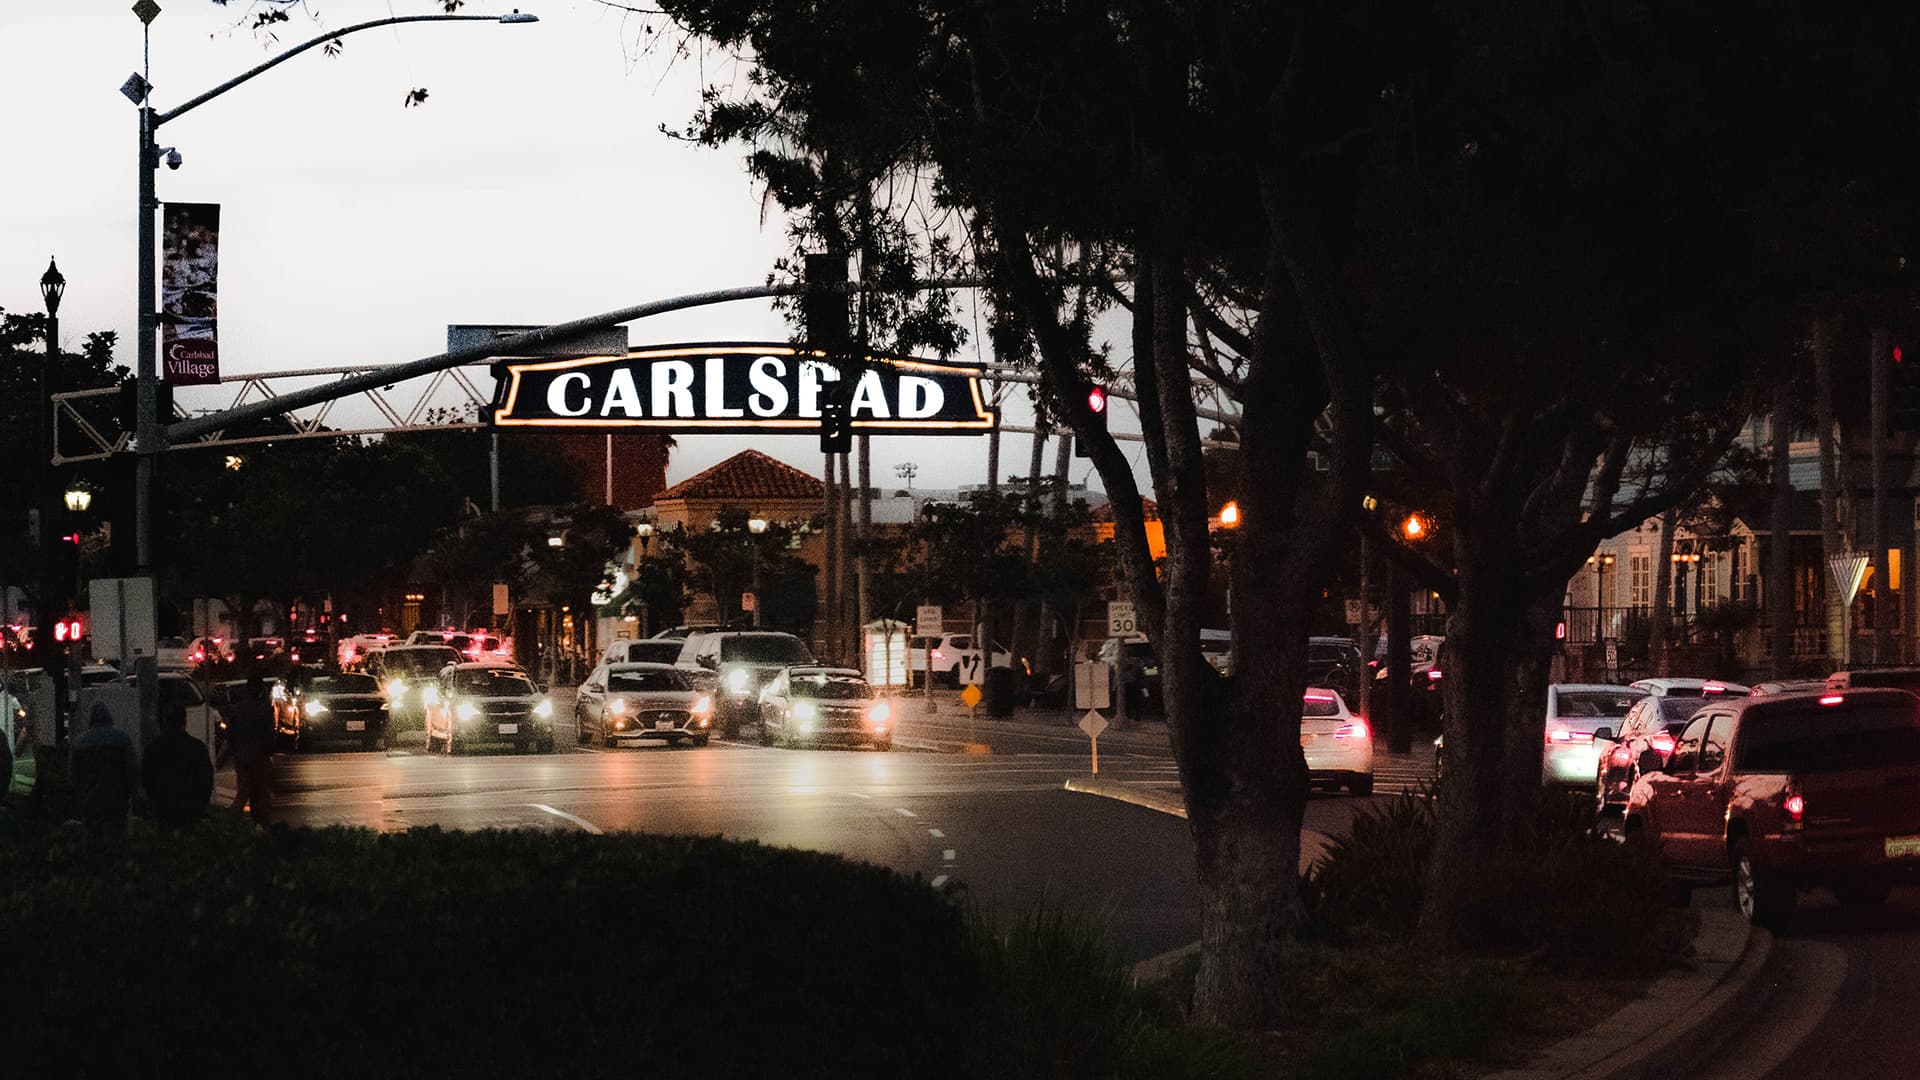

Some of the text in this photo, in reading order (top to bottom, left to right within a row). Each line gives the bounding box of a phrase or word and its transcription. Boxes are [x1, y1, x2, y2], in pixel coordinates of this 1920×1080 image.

[180, 350, 214, 359] Carlsbad
[168, 360, 215, 377] Village
[547, 357, 945, 418] CARLSBAD
[1112, 619, 1133, 632] 30
